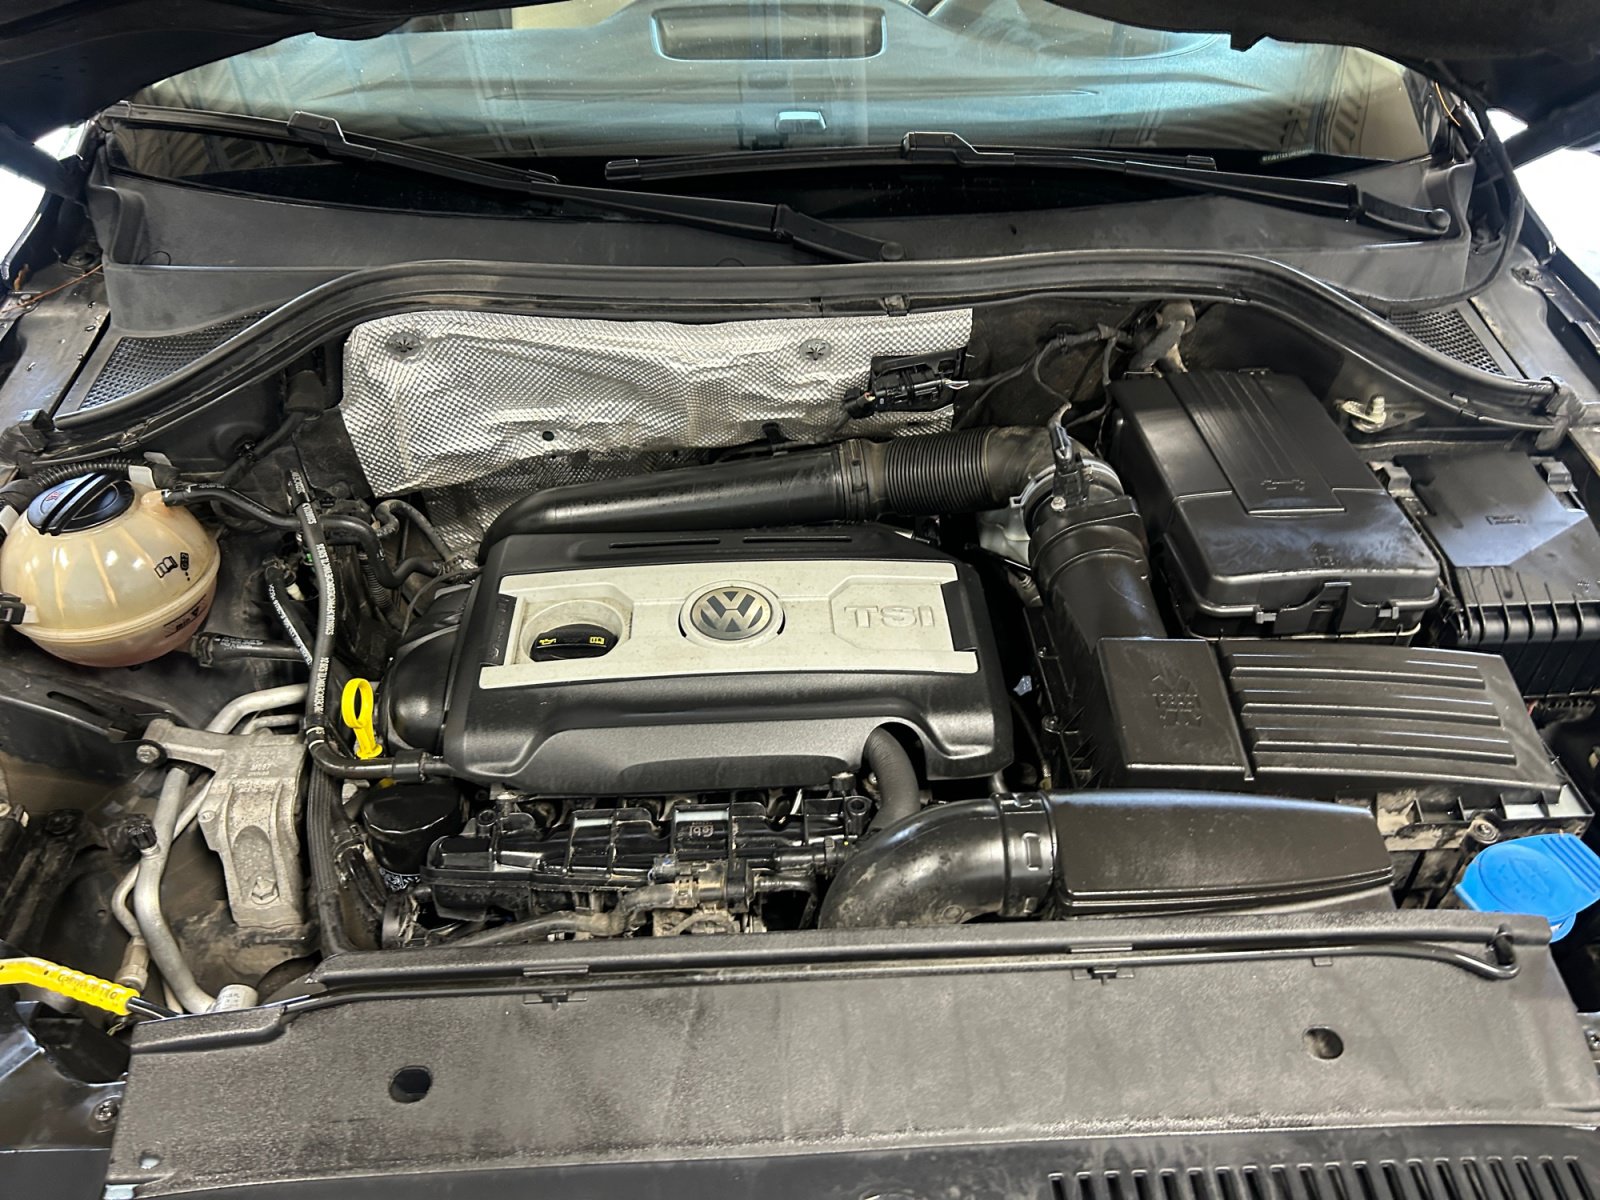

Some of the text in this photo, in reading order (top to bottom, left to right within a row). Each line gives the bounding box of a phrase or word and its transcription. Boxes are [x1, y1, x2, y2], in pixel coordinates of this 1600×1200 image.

[176, 618, 191, 630] min
[693, 588, 770, 638] VW
[844, 605, 935, 628] TSI
